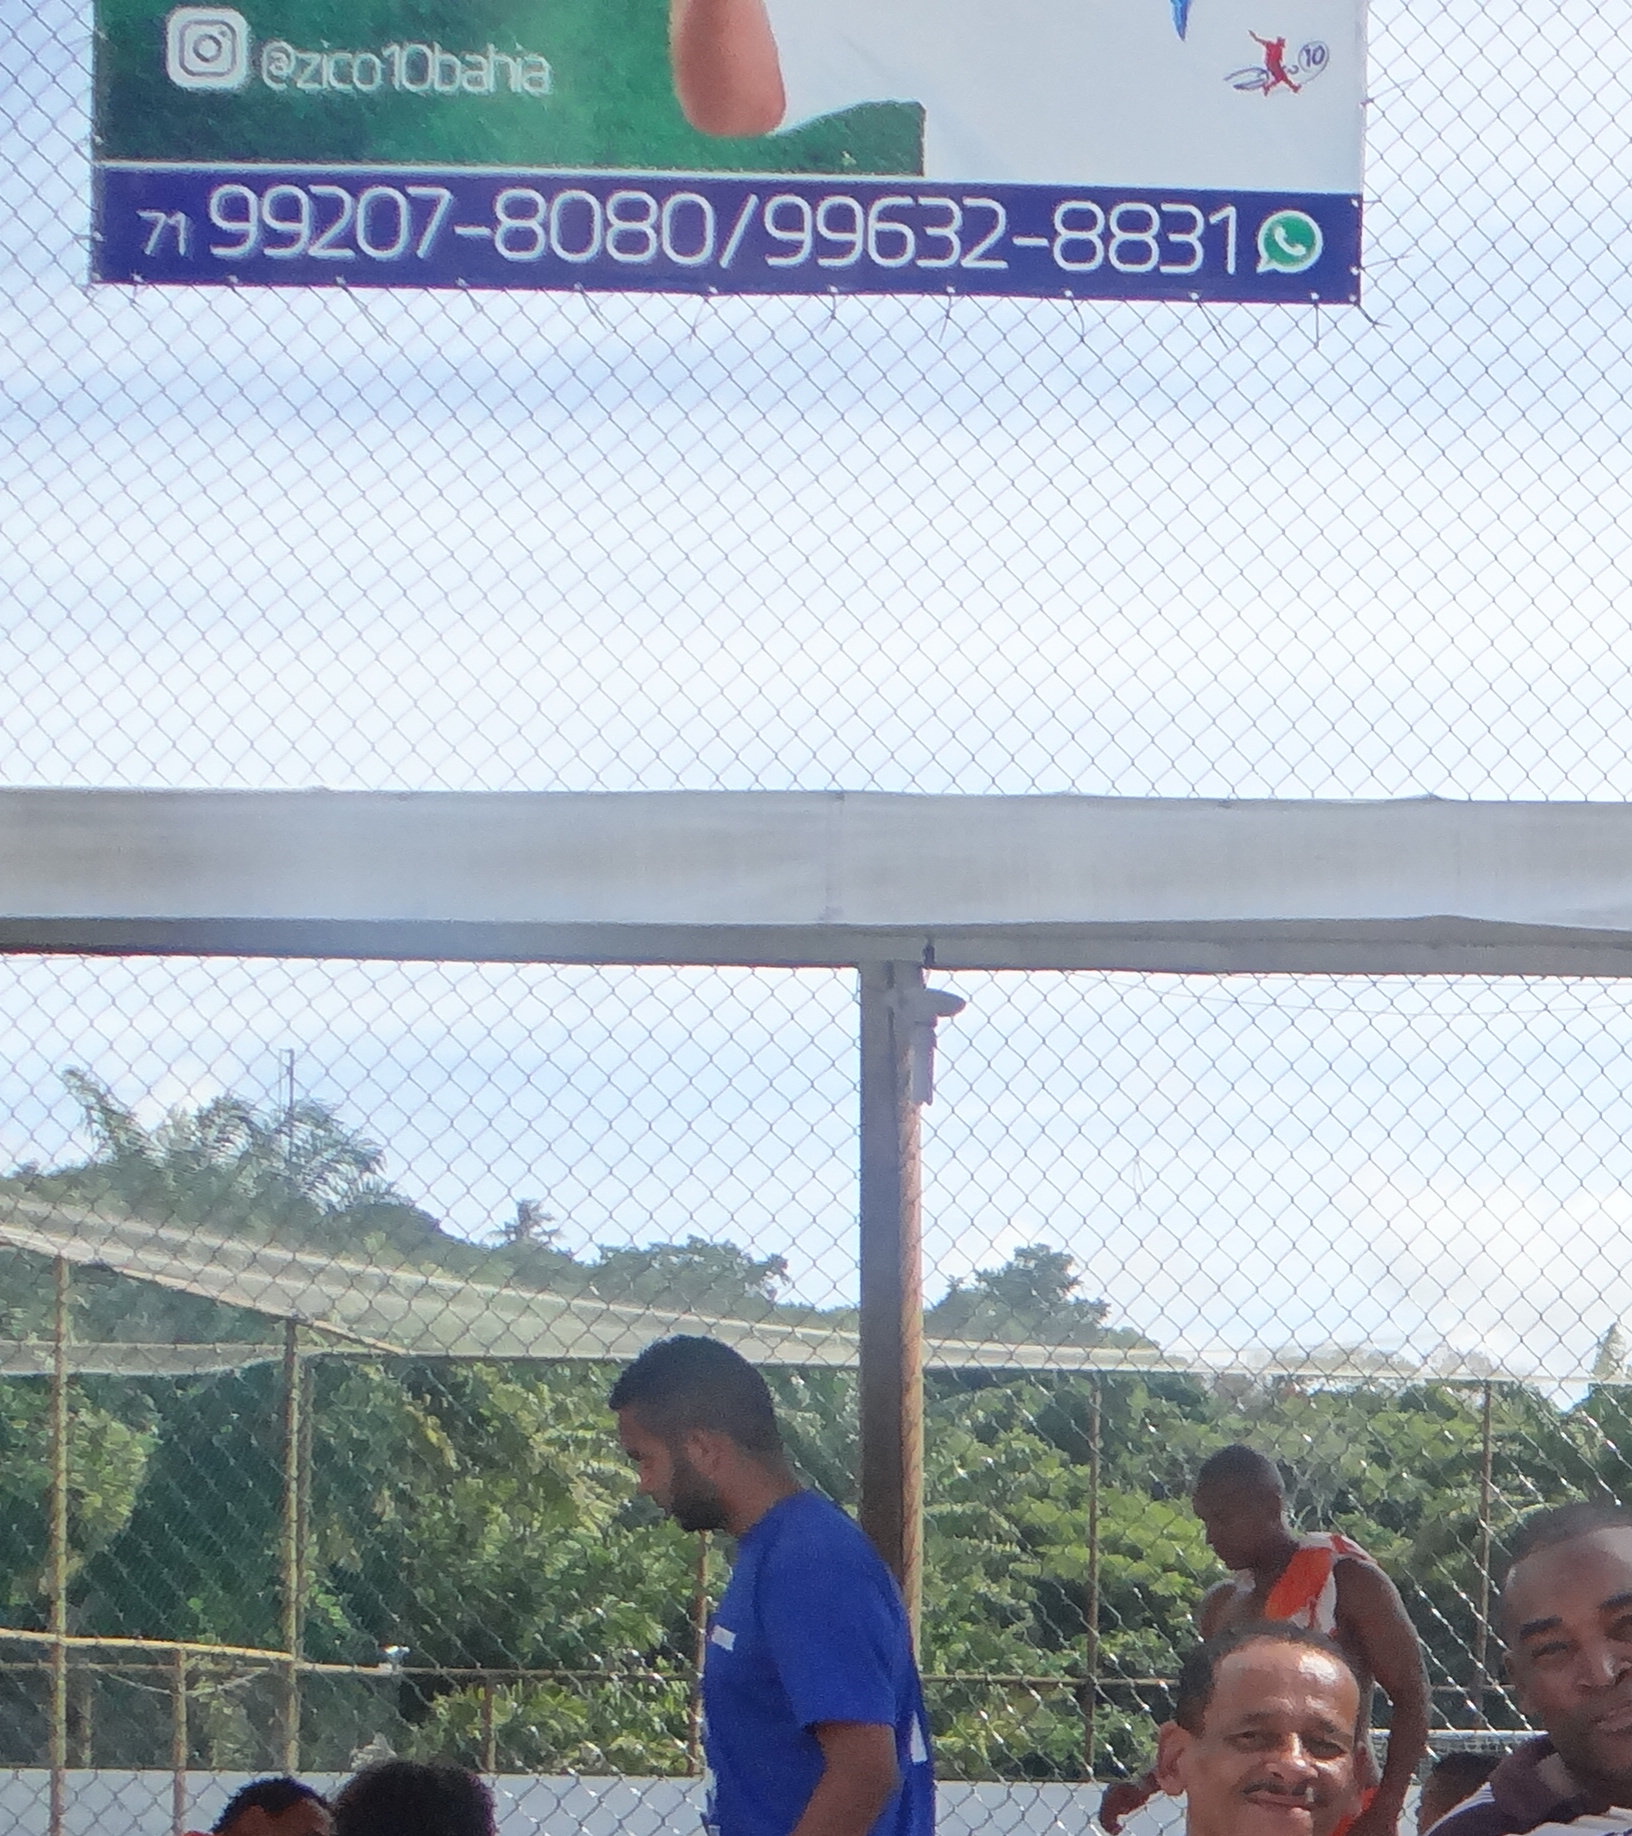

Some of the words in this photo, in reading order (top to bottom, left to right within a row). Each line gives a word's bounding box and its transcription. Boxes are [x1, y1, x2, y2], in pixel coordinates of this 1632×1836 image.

[262, 40, 553, 95] @zico10bahia
[1302, 44, 1326, 68] 10
[138, 210, 191, 257] 71
[209, 184, 1237, 275] 99207-8080/99632-8831
